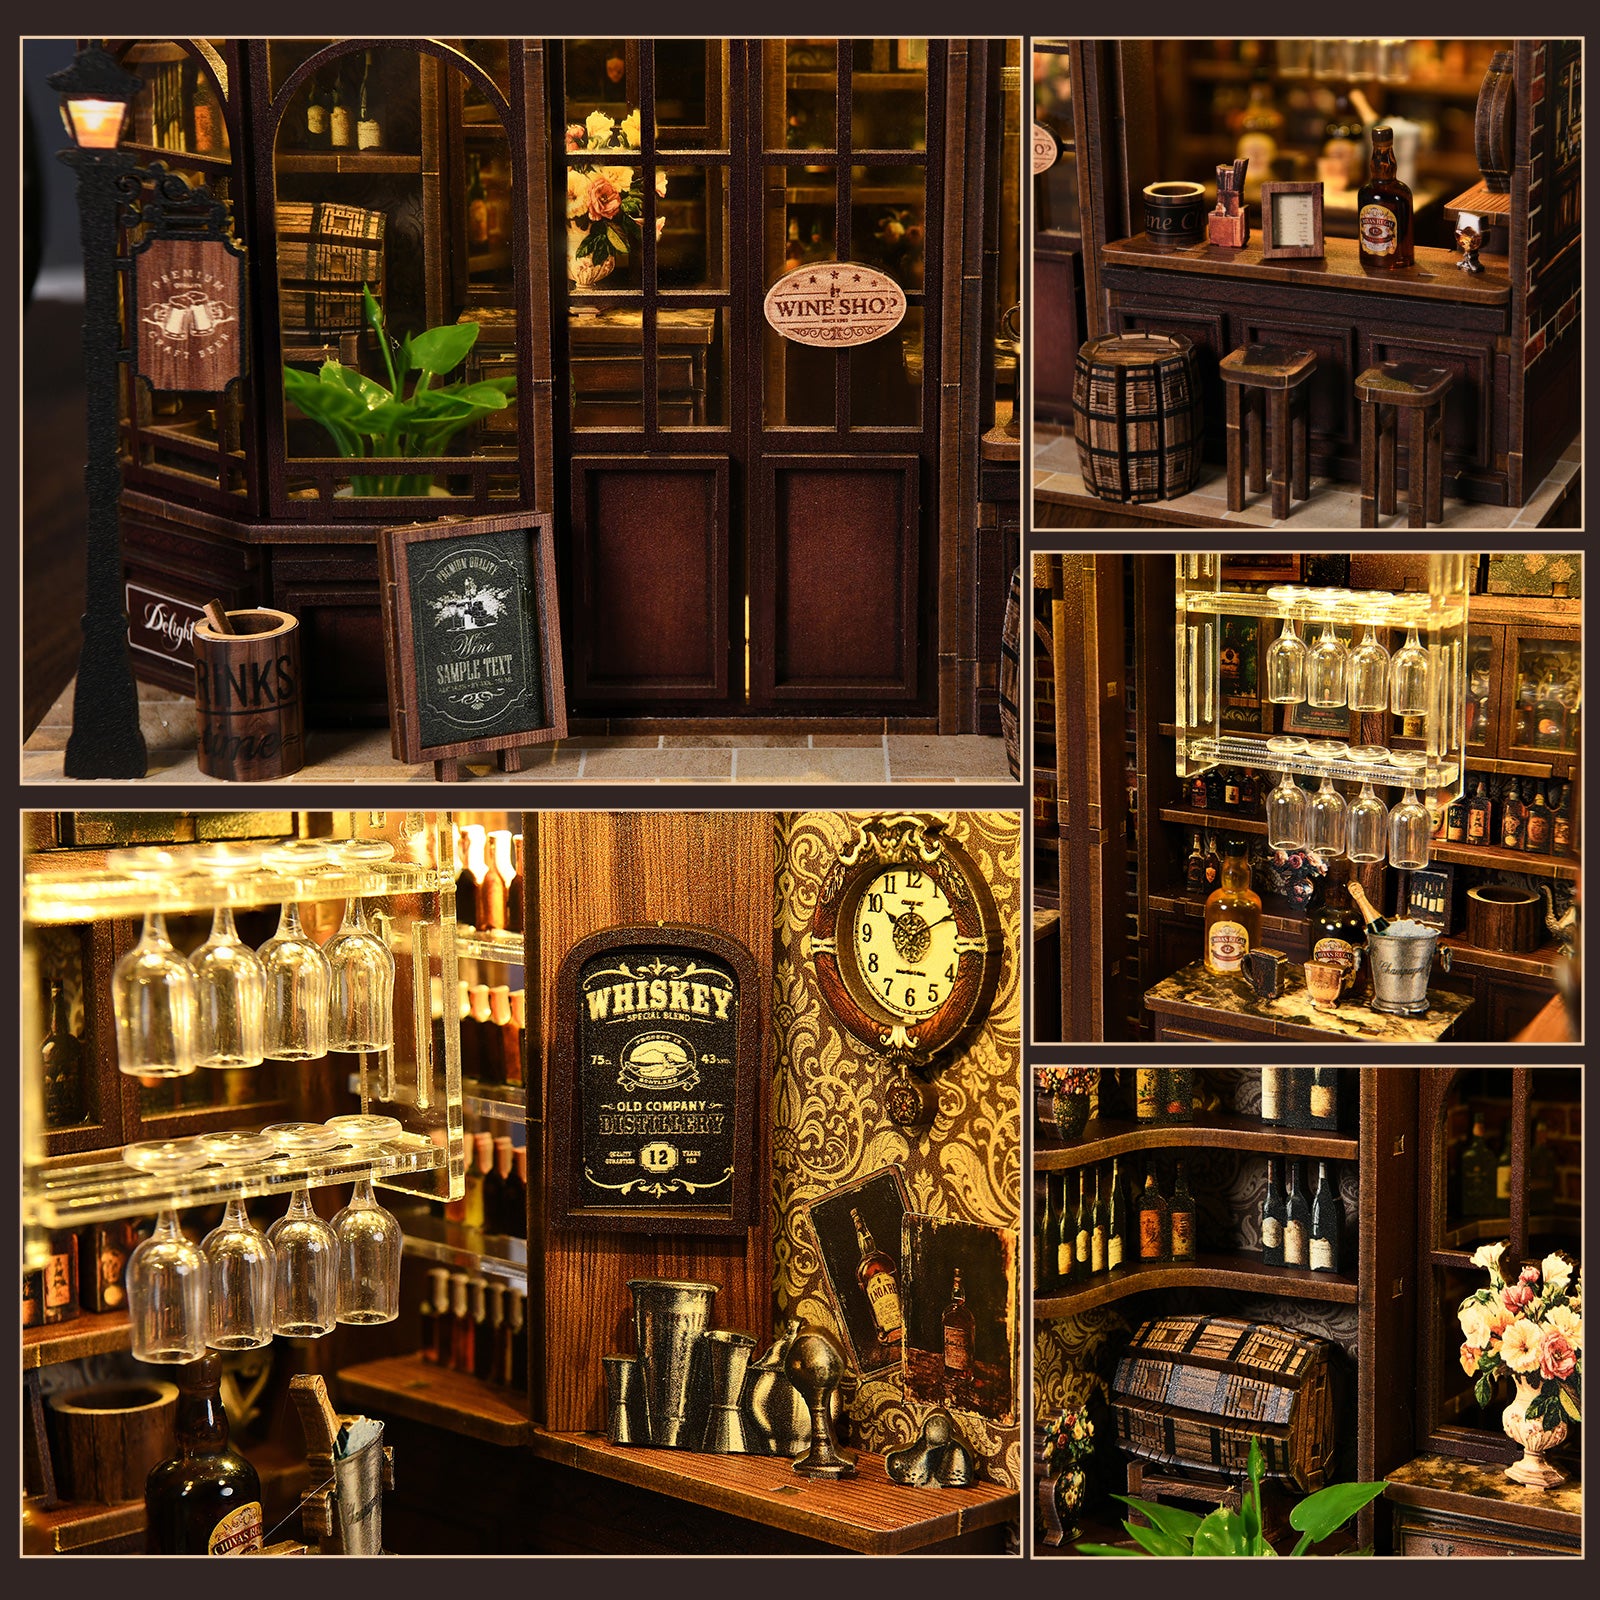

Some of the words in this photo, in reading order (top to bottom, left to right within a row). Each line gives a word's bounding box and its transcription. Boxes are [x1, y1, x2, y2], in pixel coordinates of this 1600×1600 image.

[152, 269, 224, 291] PREMIUM
[775, 299, 836, 317] WINE
[148, 330, 190, 359] CRAFT
[198, 333, 229, 358] BEER
[437, 557, 468, 583] PREMIUM
[469, 556, 499, 576] QUALITY
[144, 602, 195, 652] Delight
[452, 632, 496, 660] Wine
[437, 658, 481, 685] SAMPLE
[483, 654, 512, 678] TEXT
[202, 722, 279, 761] time
[884, 875, 897, 894] 11
[906, 869, 922, 888] 12
[868, 893, 883, 913] 10
[862, 923, 872, 943] 9
[868, 953, 878, 973] 8
[944, 963, 954, 982] 4
[883, 978, 893, 996] 7
[905, 988, 915, 1006] 6
[928, 984, 938, 1002] 5
[586, 980, 733, 1021] WHISKEY
[626, 1012, 661, 1022] SPECIAL
[663, 1012, 691, 1022] BLEND
[616, 1101, 642, 1112] OLD
[645, 1100, 706, 1112] COMPANY
[599, 1114, 724, 1135] DISTILLERY
[649, 1150, 668, 1165] 12
[213, 1530, 250, 1555] CHIVAS
